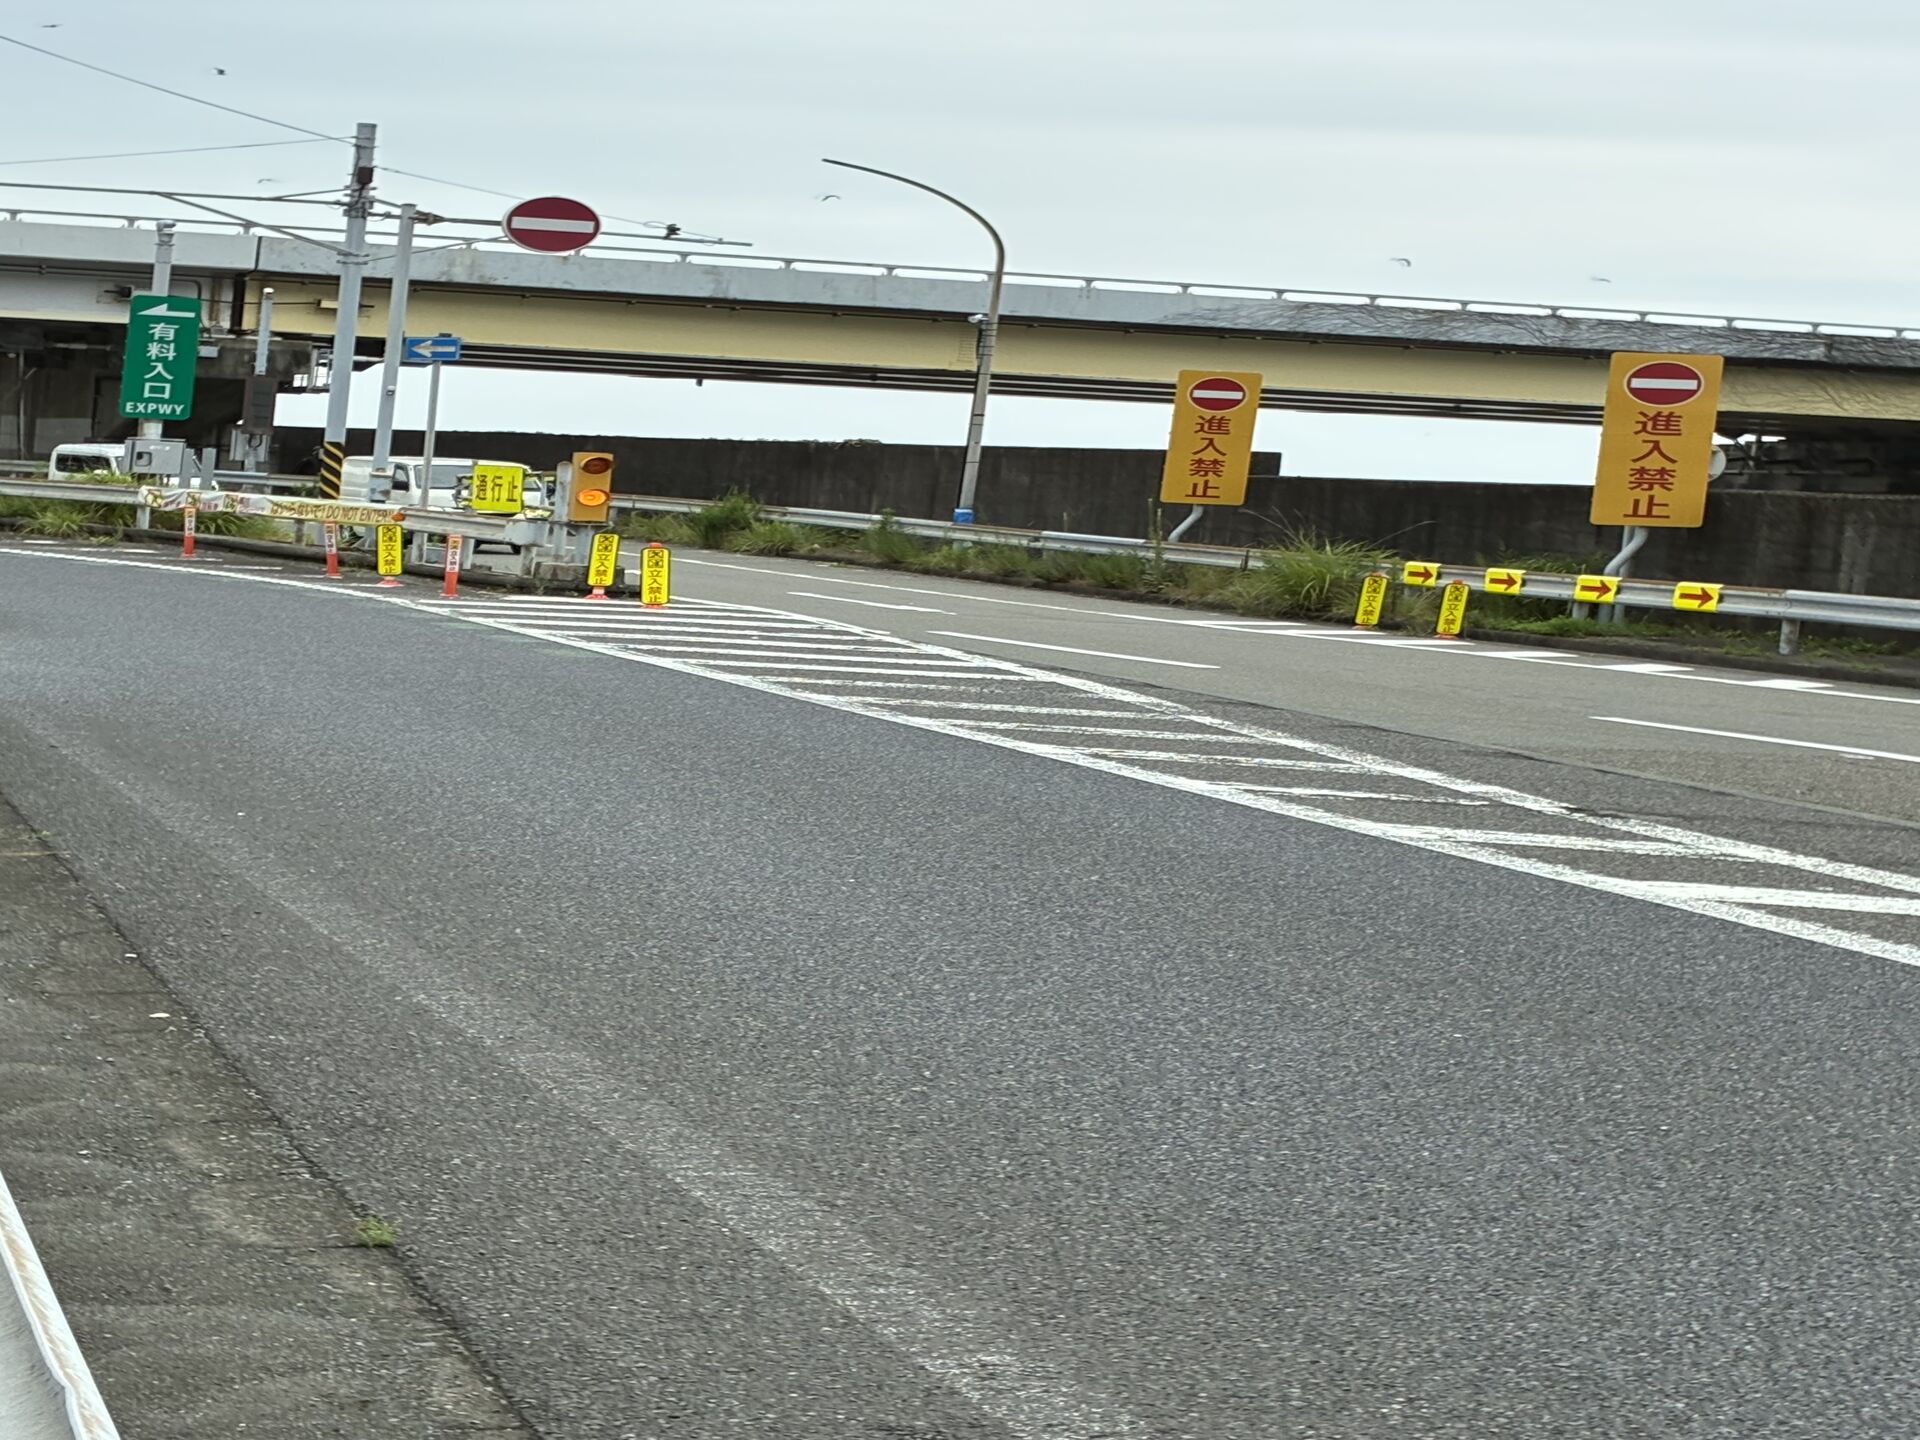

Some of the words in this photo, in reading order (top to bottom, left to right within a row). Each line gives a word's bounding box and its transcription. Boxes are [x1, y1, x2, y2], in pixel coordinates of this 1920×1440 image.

[143, 322, 180, 400] 有料入口
[125, 402, 185, 415] EXPWY
[1184, 415, 1232, 499] 進入禁止
[1622, 411, 1684, 519] 進入禁止
[475, 474, 519, 503] 通行止
[326, 505, 341, 519] DO
[341, 506, 359, 521] NOT
[383, 543, 397, 574] 立入禁止
[593, 554, 611, 585] 立入禁止
[648, 569, 663, 603] 立入禁止
[1362, 595, 1377, 624] 立入禁止
[1443, 603, 1459, 634] 立入禁止
